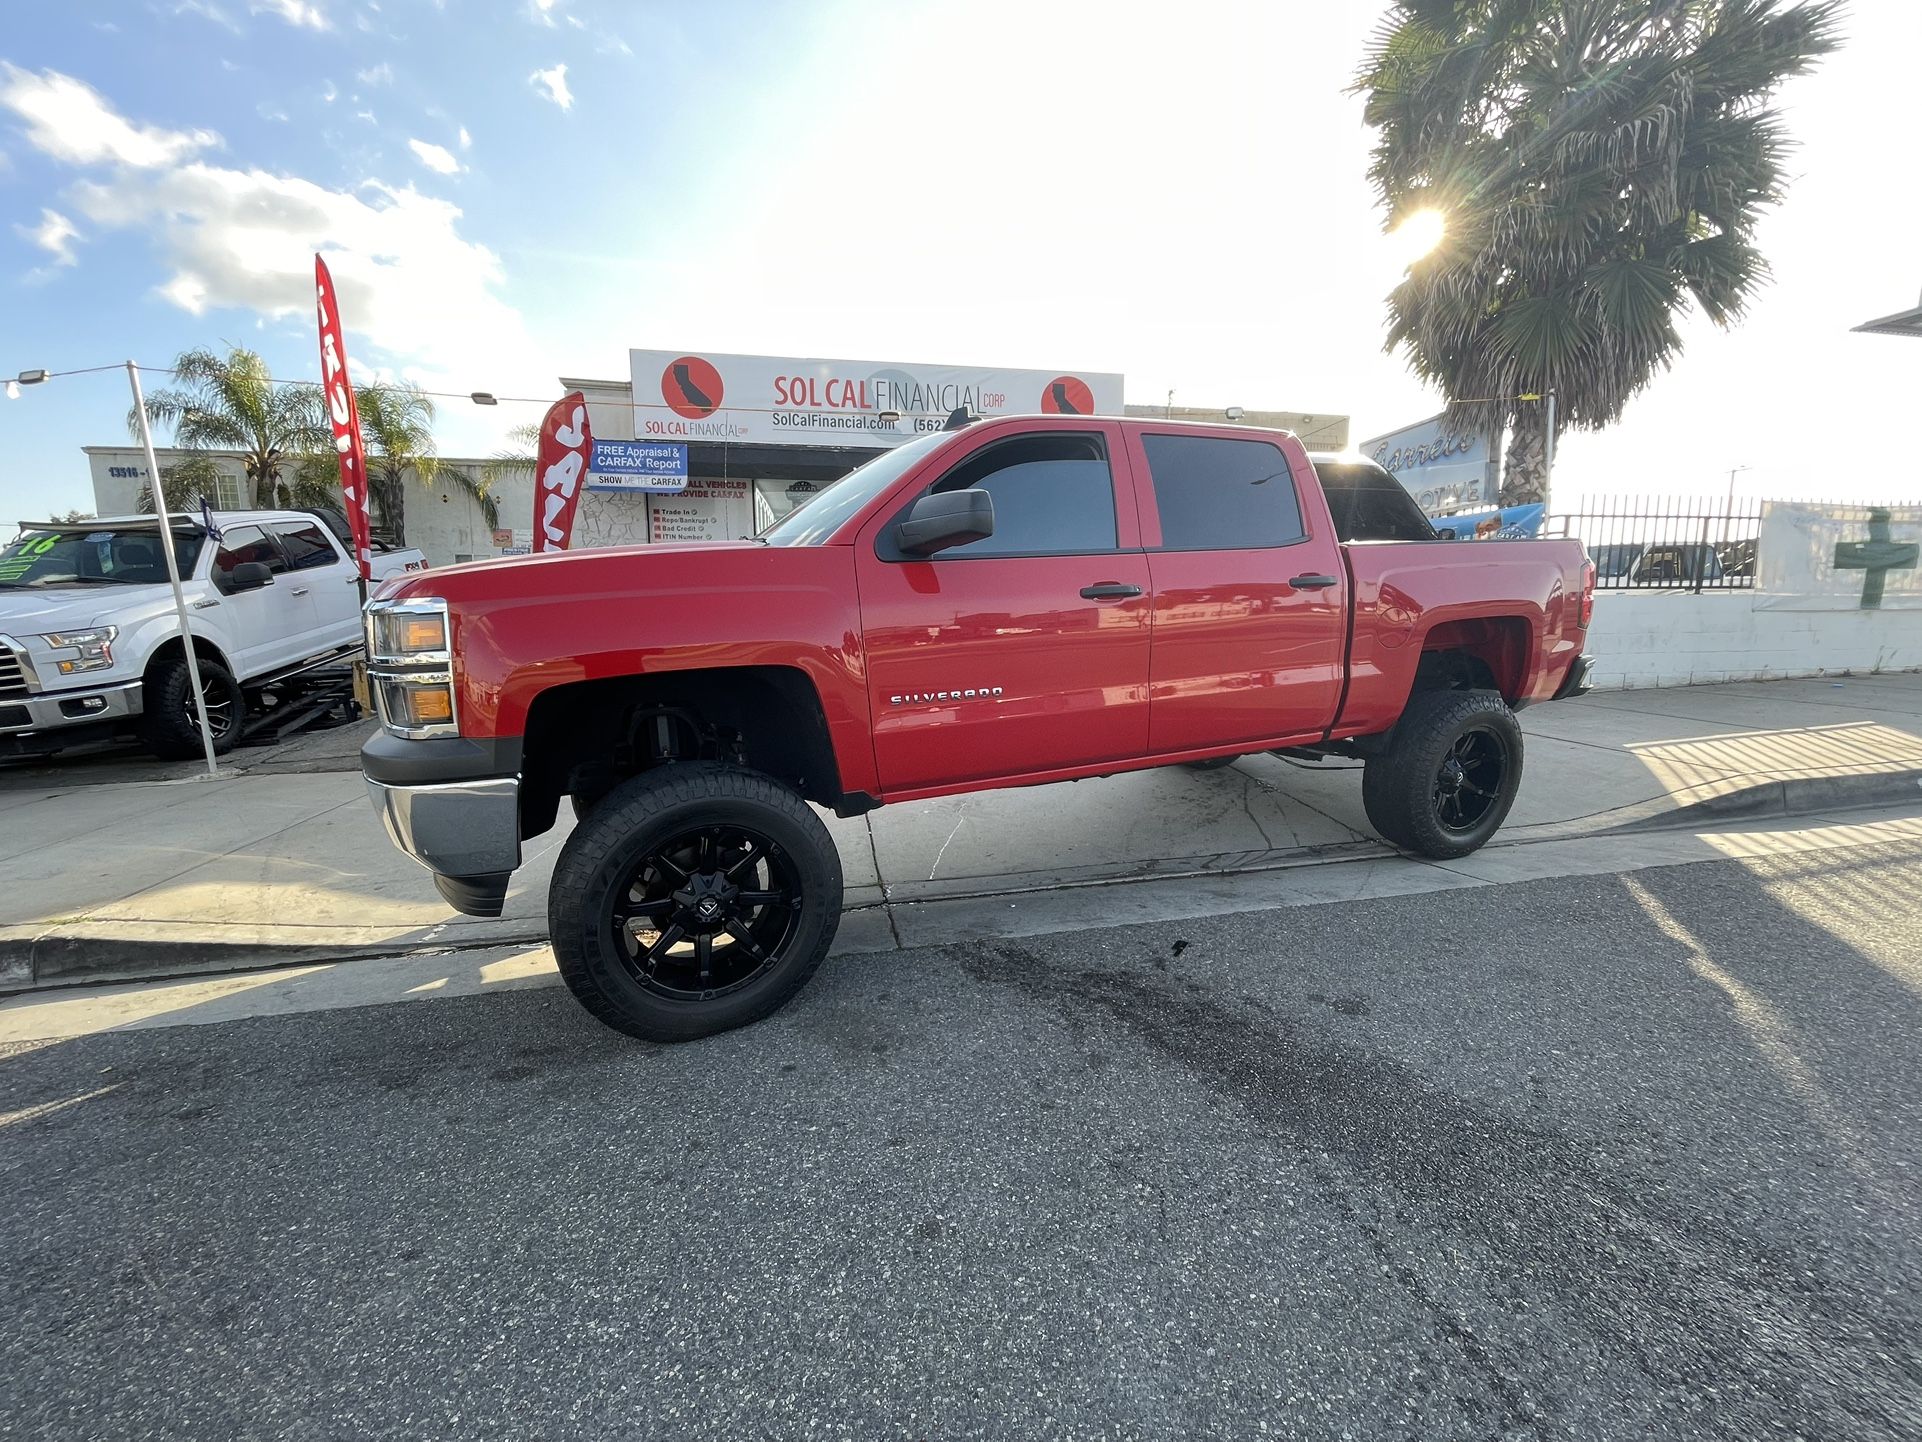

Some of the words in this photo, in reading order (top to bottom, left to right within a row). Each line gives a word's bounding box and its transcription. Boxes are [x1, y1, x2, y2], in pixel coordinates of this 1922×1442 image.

[876, 381, 987, 413] FINANCIAL
[983, 393, 1005, 408] CORP
[772, 413, 895, 430] SolCalFinancial.com
[913, 418, 946, 433] (562
[689, 423, 740, 437] FINANCIAL
[597, 445, 625, 455] FREE
[626, 447, 671, 458] Appraisal
[672, 448, 680, 457] &
[597, 457, 642, 467] CARFAX
[646, 459, 681, 470] Report
[599, 476, 622, 484] SHOW
[651, 478, 682, 486] CARFAX
[706, 481, 747, 489] VEHICLES
[672, 490, 709, 498] PROVIDE
[711, 491, 744, 499] CARFAX
[890, 687, 1003, 705] SILVERADO
